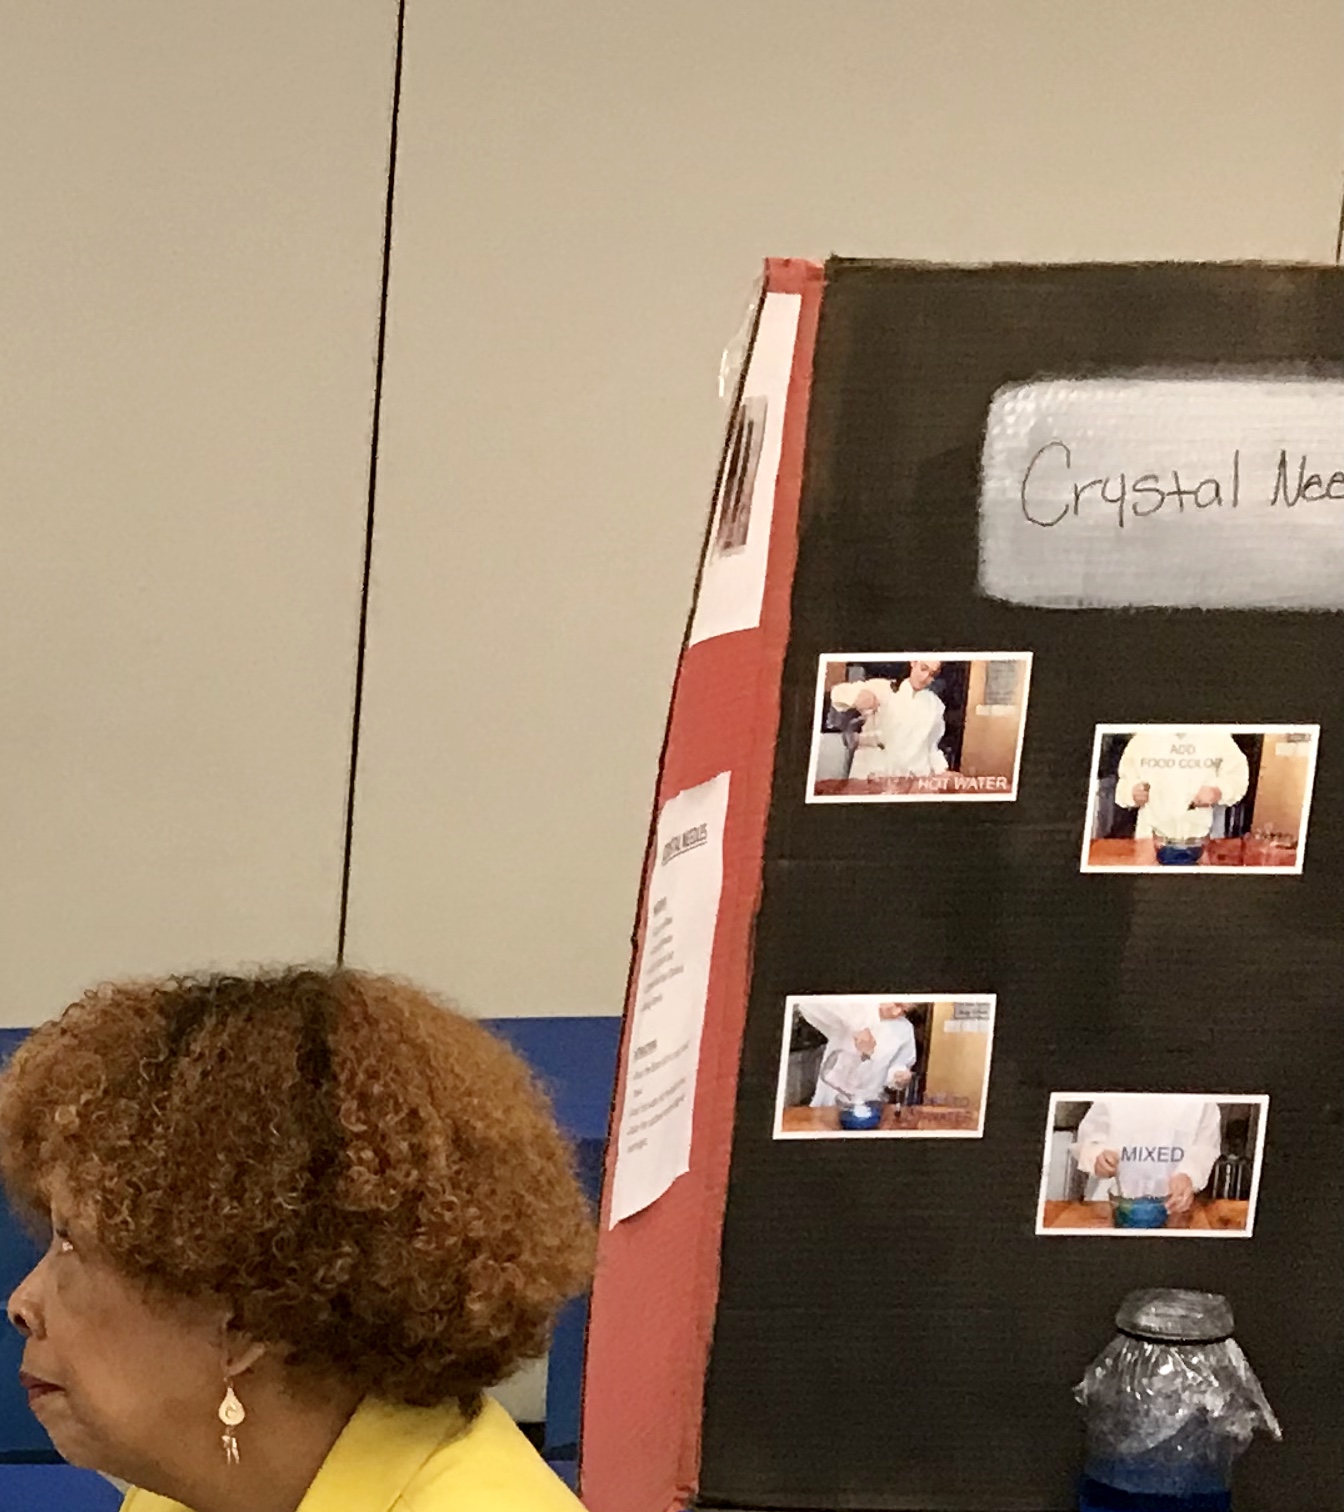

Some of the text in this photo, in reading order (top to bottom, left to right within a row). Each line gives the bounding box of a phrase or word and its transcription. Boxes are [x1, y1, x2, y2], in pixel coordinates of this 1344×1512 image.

[1021, 440, 1344, 527] Crystal Nee
[919, 777, 1007, 790] HOT WATER
[1121, 1146, 1184, 1162] MIXED
